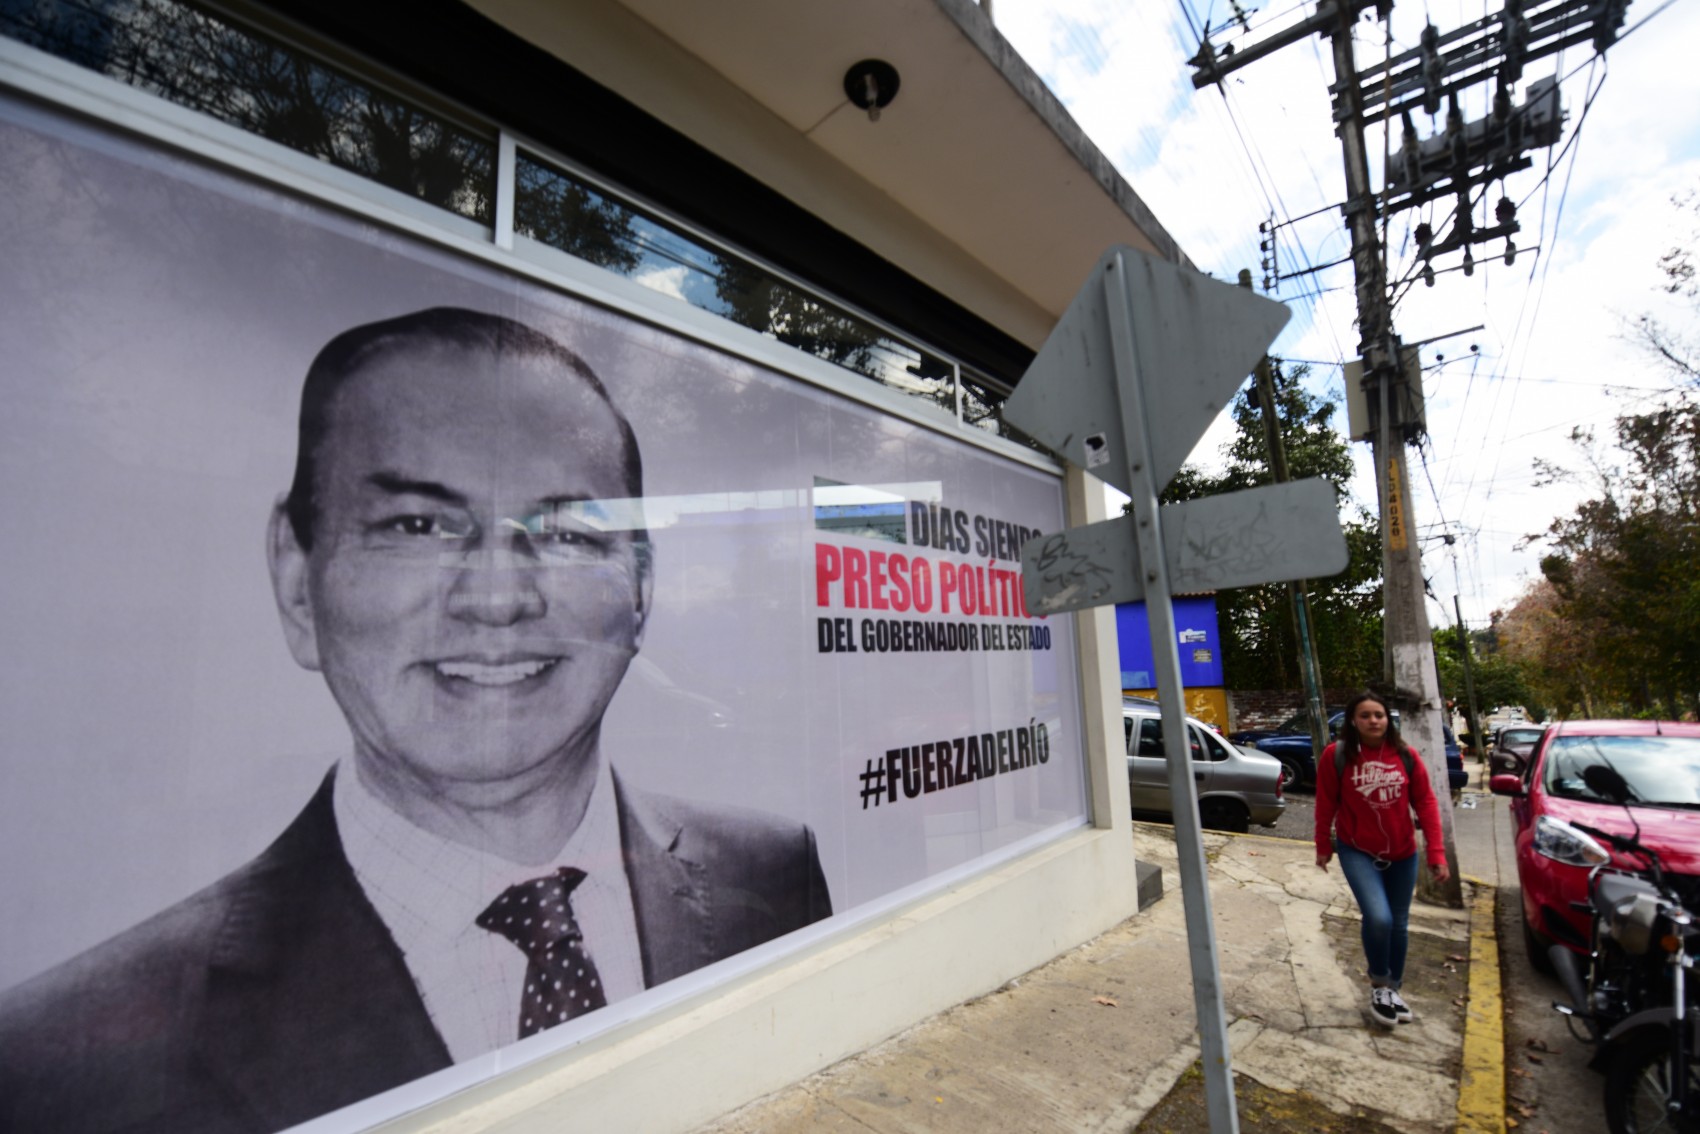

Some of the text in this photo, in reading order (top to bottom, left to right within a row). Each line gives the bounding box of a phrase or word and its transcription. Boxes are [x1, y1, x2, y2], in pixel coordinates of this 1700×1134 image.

[911, 498, 970, 555] DÍAS
[974, 514, 1042, 563] SIEN
[815, 542, 933, 614] PRESO
[938, 558, 1048, 620] POLÍTIC
[818, 617, 1051, 653] DEL GOBERNADOR DEL ESTADO
[859, 717, 1050, 810] #FUERZADELRÍO
[1379, 784, 1402, 802] NYC
